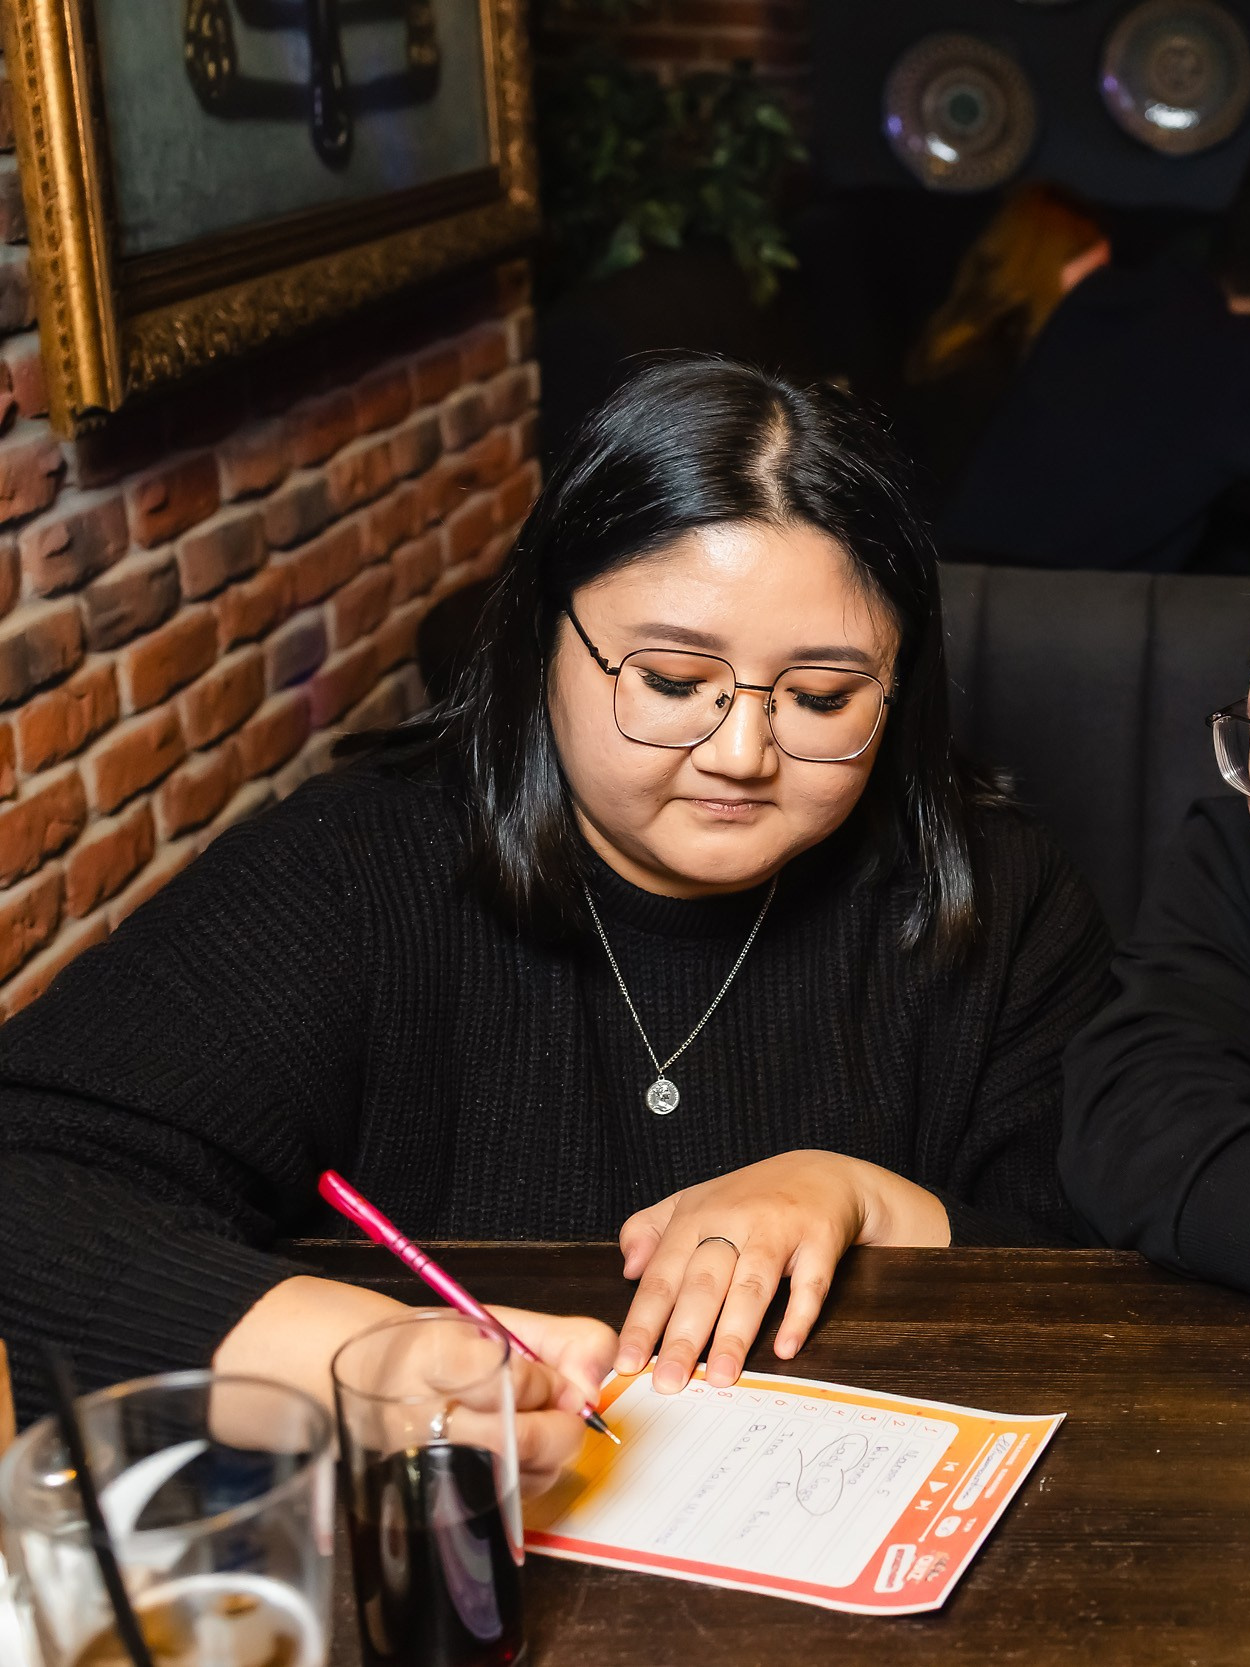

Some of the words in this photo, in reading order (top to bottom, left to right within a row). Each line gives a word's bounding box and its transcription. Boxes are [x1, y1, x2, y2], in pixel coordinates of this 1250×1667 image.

[717, 1390, 733, 1399] 8
[748, 1394, 761, 1403] 7
[774, 1399, 788, 1407] 6
[803, 1404, 818, 1412] 5
[832, 1409, 846, 1417] 4
[861, 1413, 877, 1422] 3
[893, 1419, 906, 1428] 2
[924, 1425, 938, 1434] 1
[818, 1441, 857, 1469] Lady
